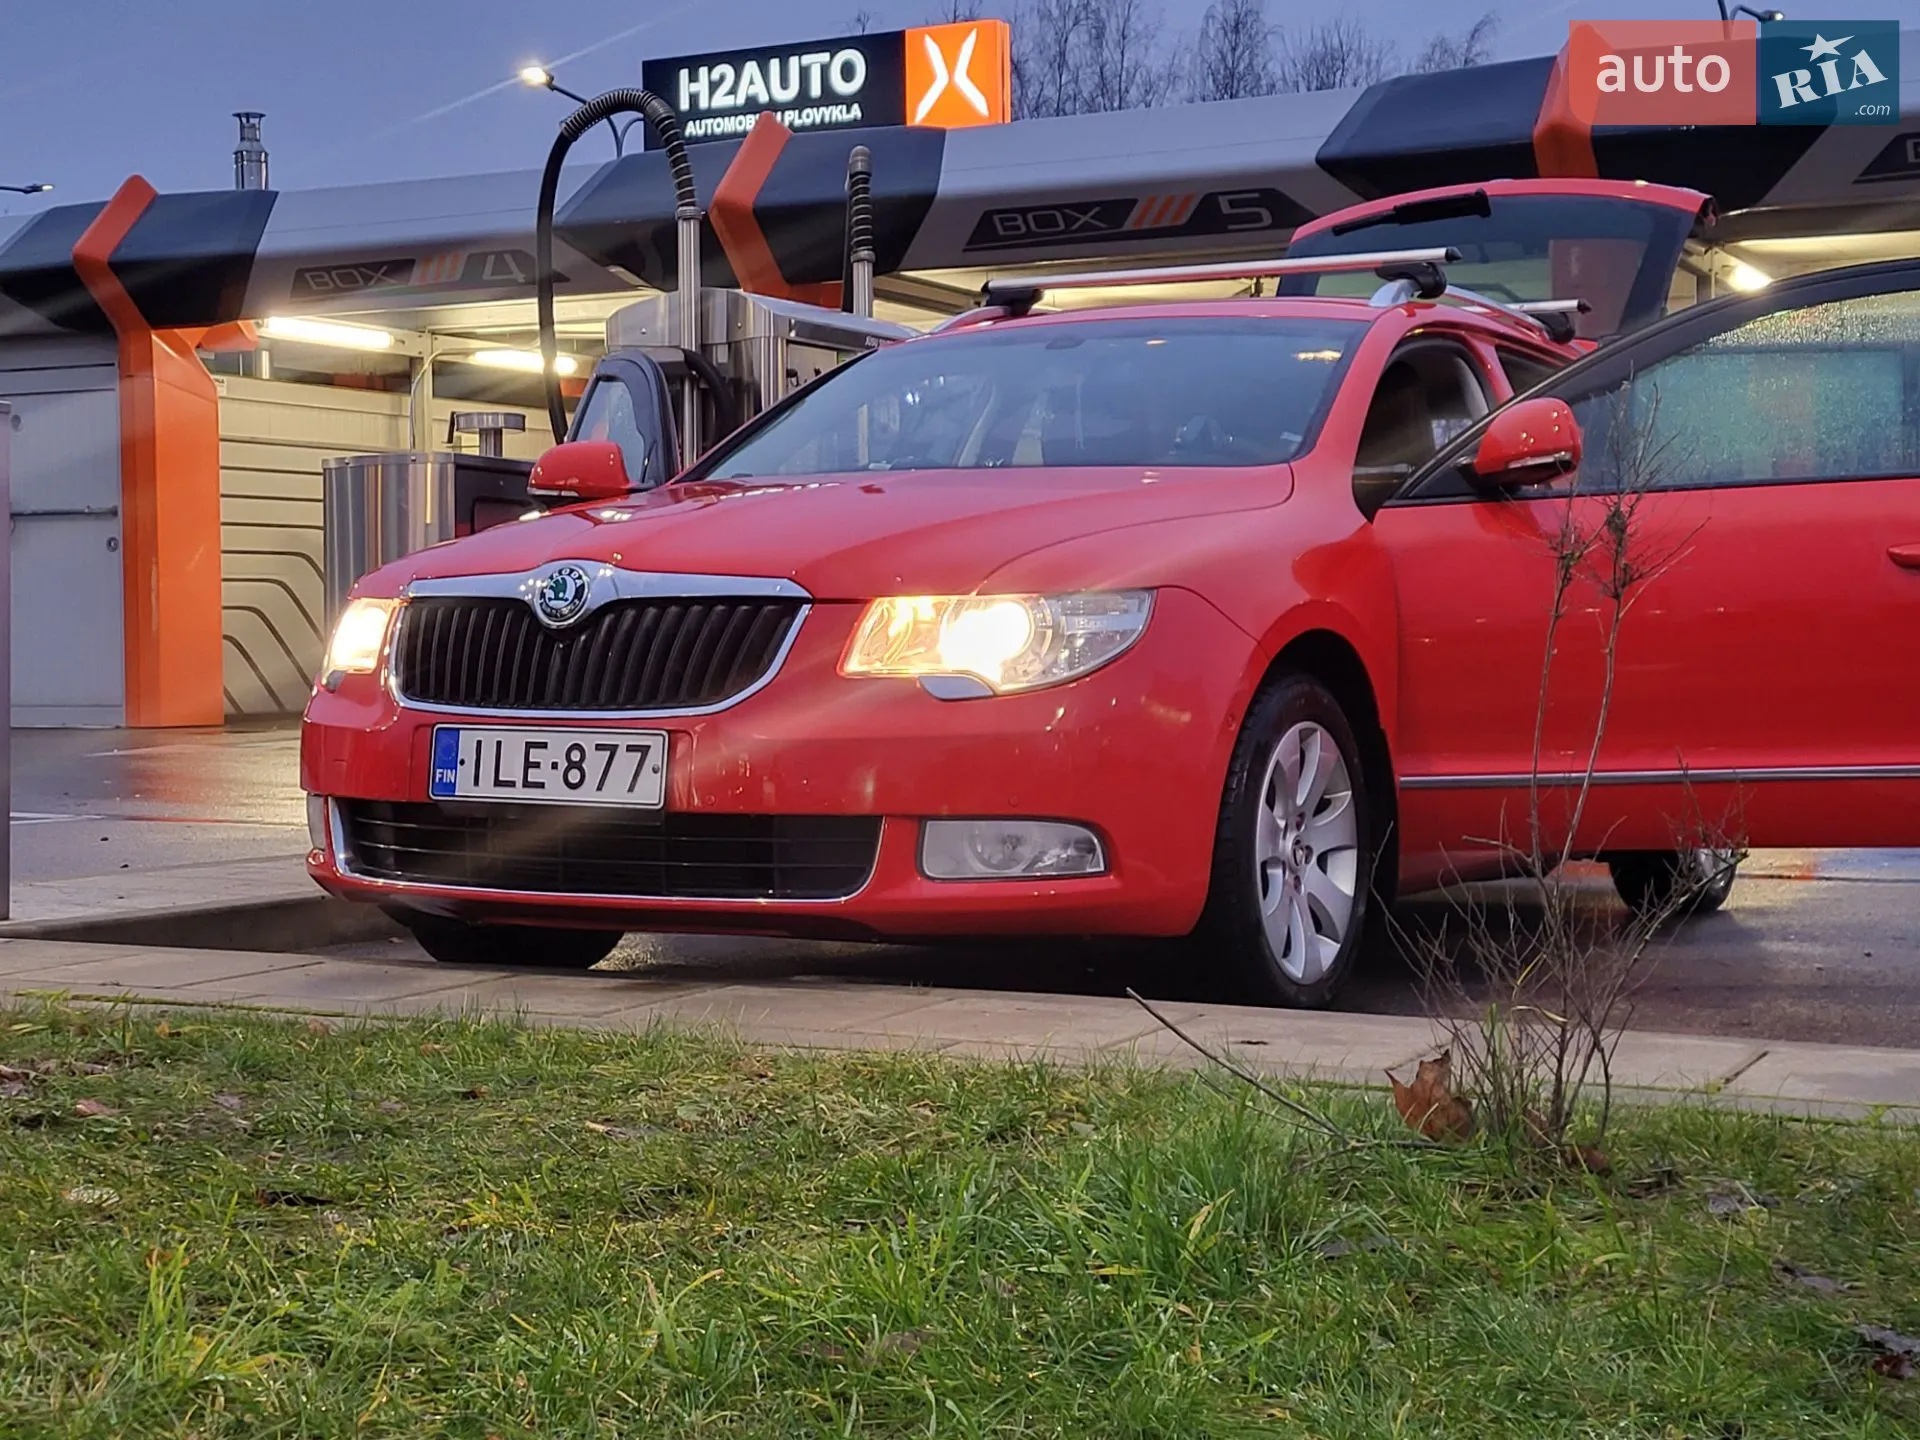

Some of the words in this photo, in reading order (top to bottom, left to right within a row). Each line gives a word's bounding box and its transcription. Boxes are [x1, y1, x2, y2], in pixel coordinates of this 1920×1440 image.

[678, 48, 866, 112] H2AUTO
[784, 102, 862, 127] PLOVYKLA
[993, 206, 1108, 236] BOX
[1218, 193, 1273, 230] 5
[304, 265, 397, 291] BOX
[482, 253, 526, 283] 4
[435, 768, 456, 784] FIN
